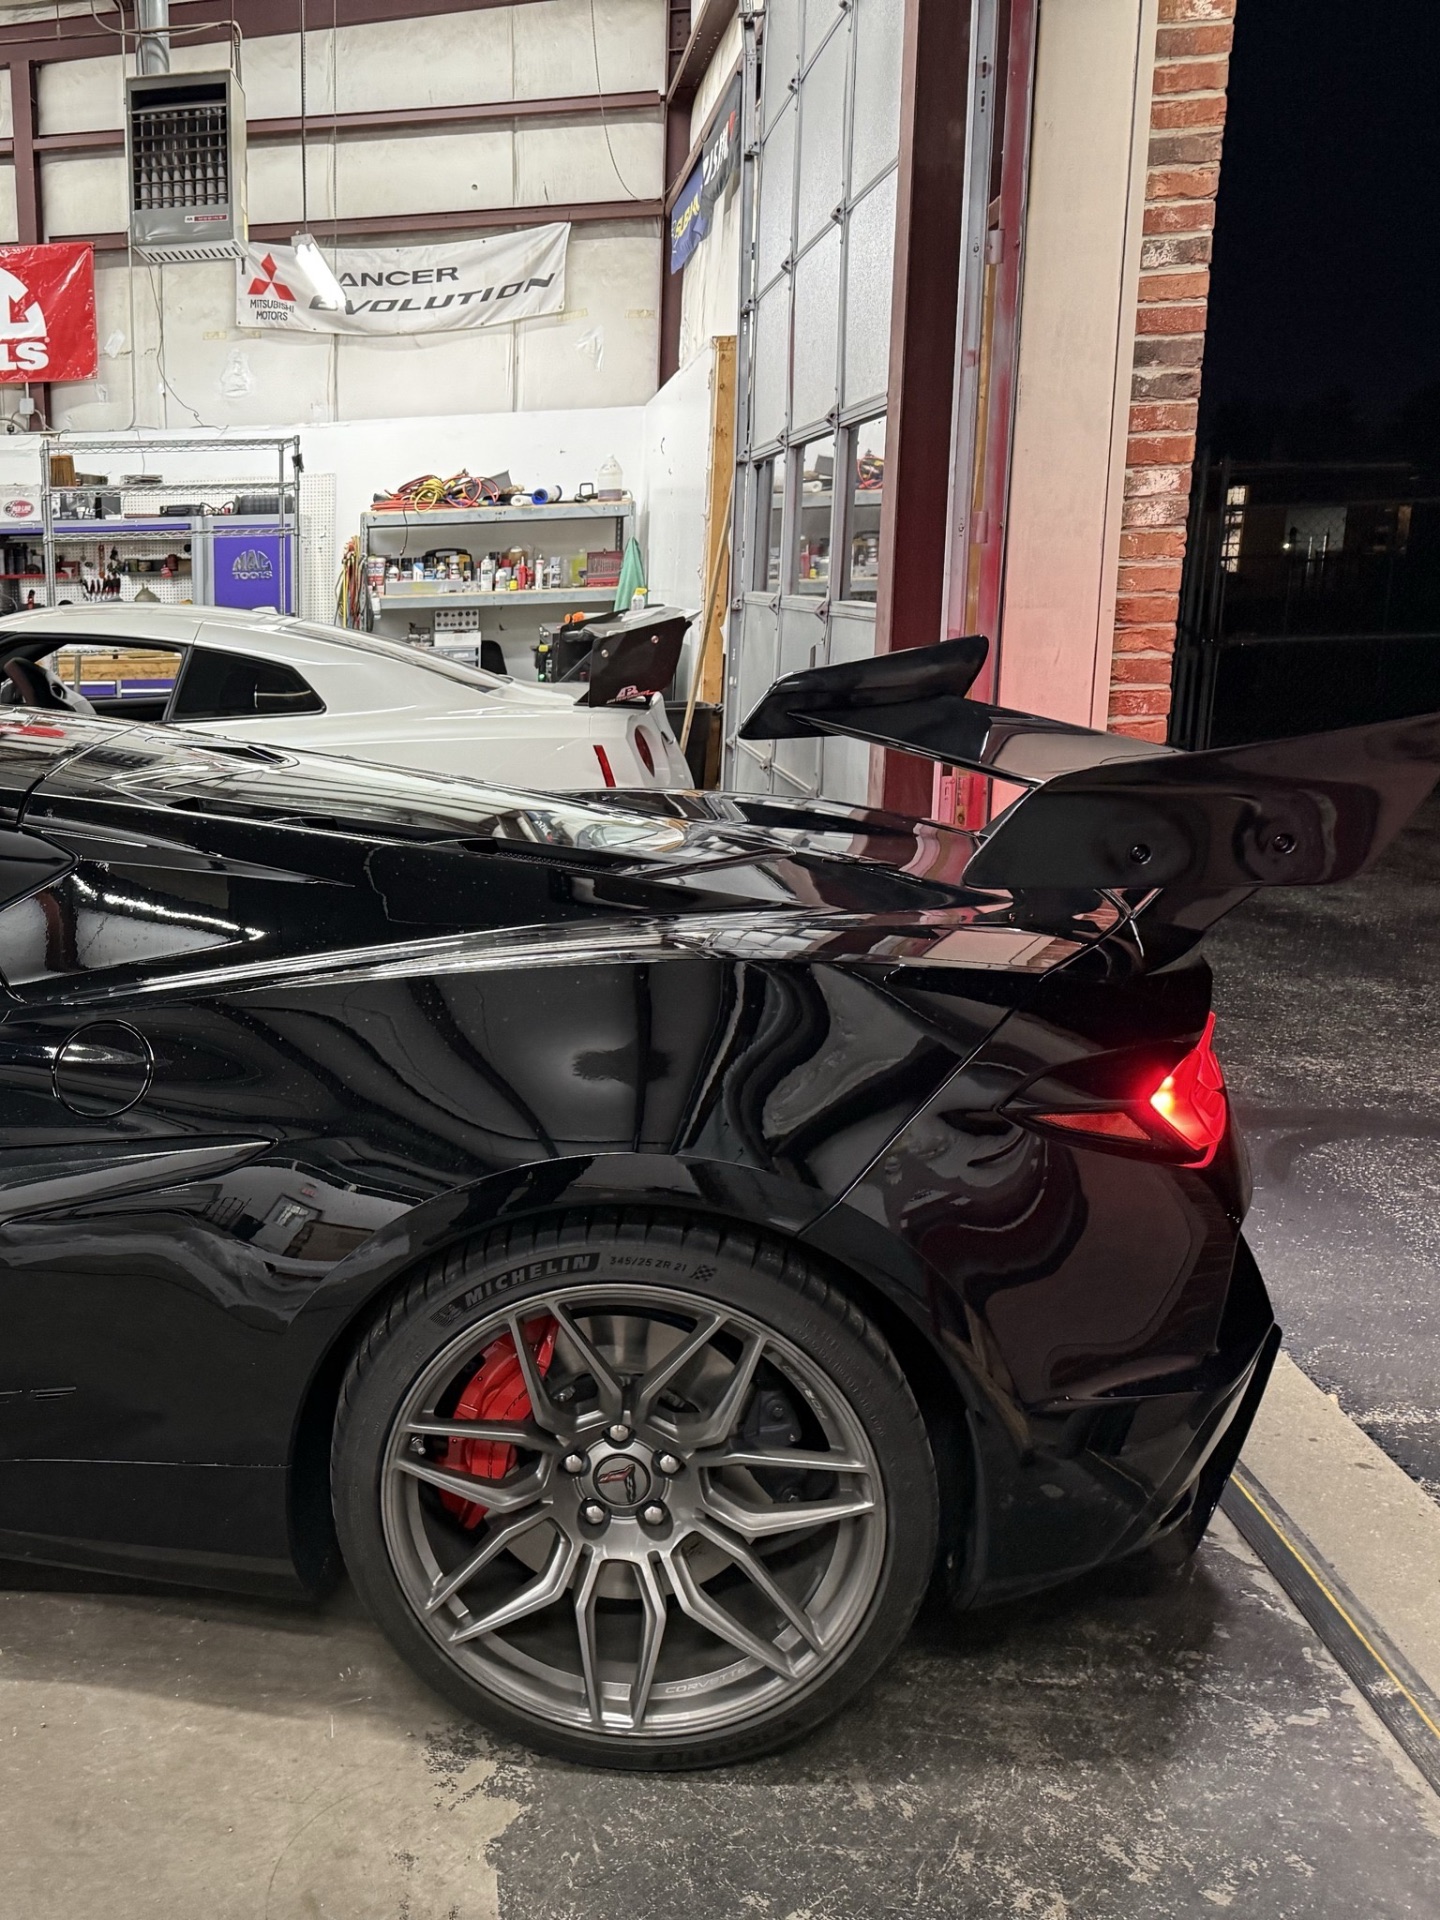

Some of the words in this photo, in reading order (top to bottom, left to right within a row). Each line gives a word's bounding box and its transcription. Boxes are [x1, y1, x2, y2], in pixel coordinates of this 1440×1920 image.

[340, 267, 459, 287] ANCER
[250, 299, 294, 313] MITSUBISHI
[256, 310, 288, 321] MOTORS
[232, 571, 273, 580] TOOLS
[610, 1256, 653, 1267] 345/25
[655, 1260, 671, 1269] ZR
[674, 1263, 688, 1272] 21
[466, 1254, 590, 1306] MICHELIN
[665, 1664, 747, 1694] CORVETTE
